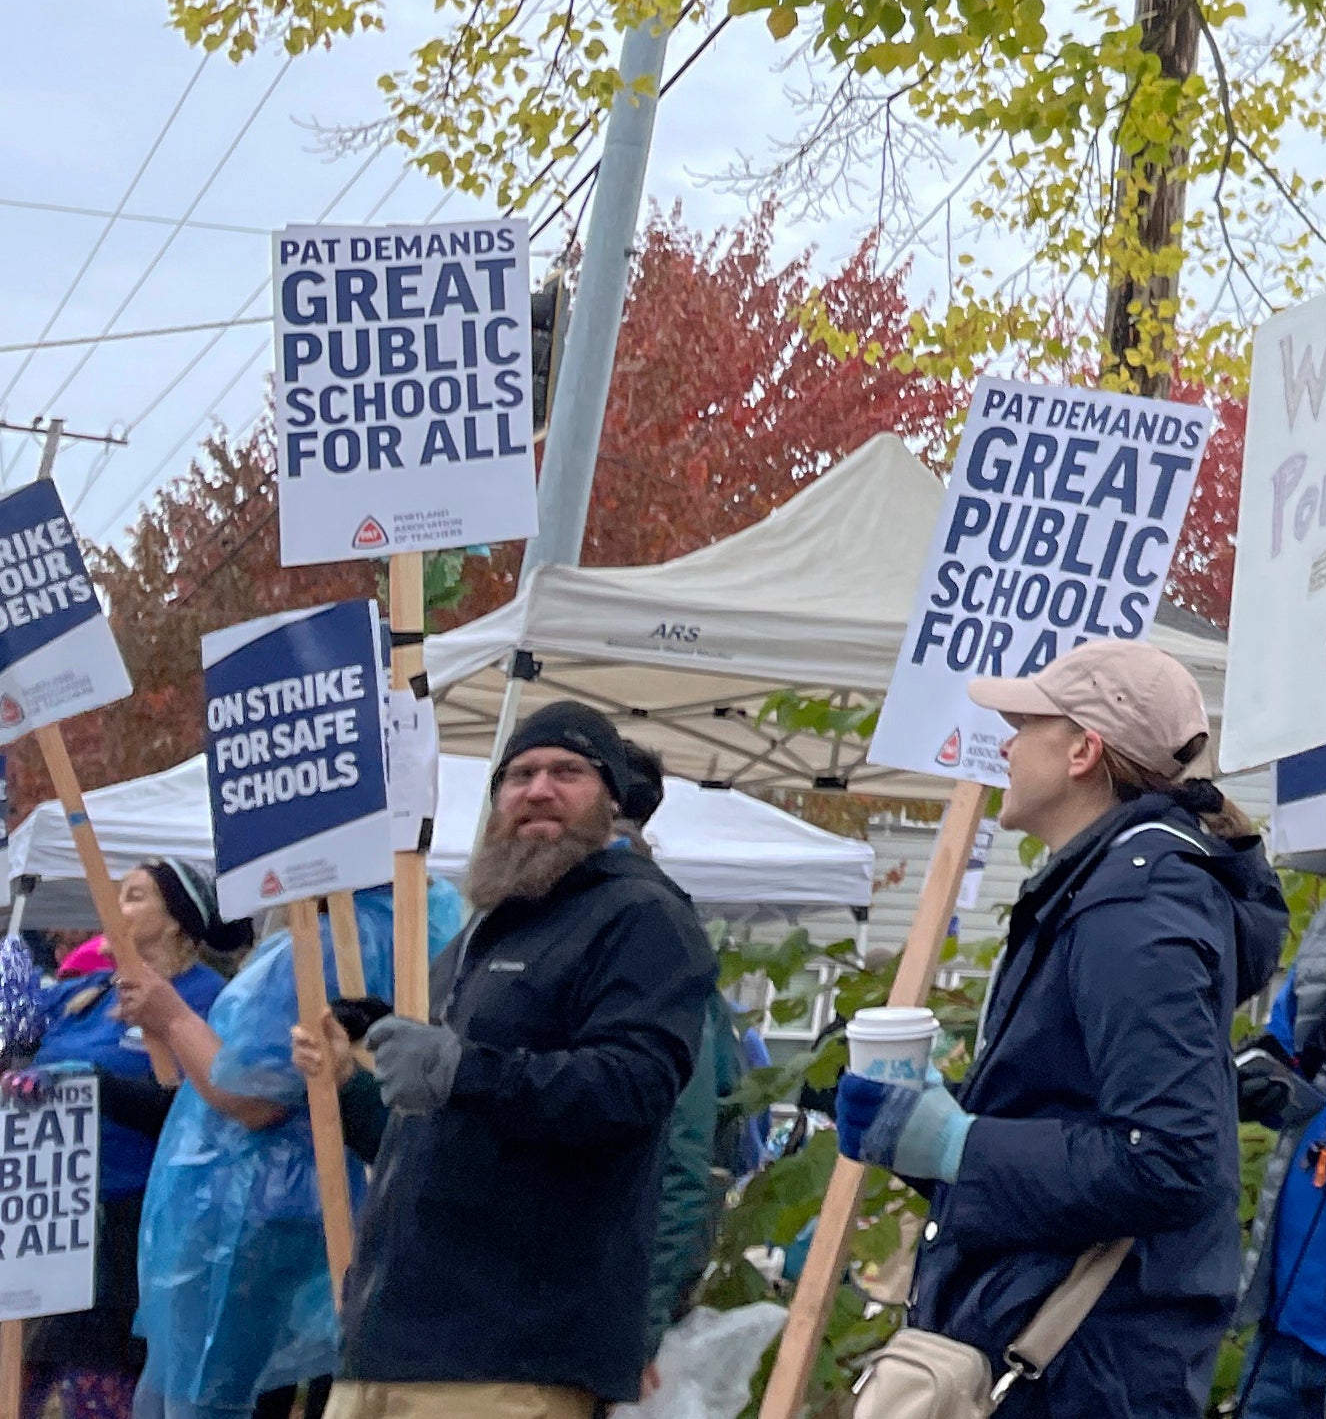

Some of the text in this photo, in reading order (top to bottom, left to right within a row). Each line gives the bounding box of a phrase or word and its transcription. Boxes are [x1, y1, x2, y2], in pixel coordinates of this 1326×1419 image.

[280, 228, 516, 265] PAT DEMANDS
[281, 258, 517, 326] GREAT
[282, 317, 522, 383] PUBLIC
[285, 369, 525, 427] SCHOOLS
[982, 388, 1204, 451] PAT DEMANDS
[287, 412, 528, 479] FOR ALL
[965, 425, 1195, 521] GREAT
[0, 548, 71, 598] OUR
[943, 494, 1170, 588] PUBLIC
[930, 559, 1151, 640] SCHOOLS
[910, 609, 1014, 678] FOR
[206, 664, 365, 732] ON STRIKE
[215, 729, 270, 774] FOR
[272, 708, 359, 760] SAFE
[221, 751, 360, 815] SCHOOLS
[3, 1106, 93, 1153] EAT
[15, 1218, 90, 1259] ALL
